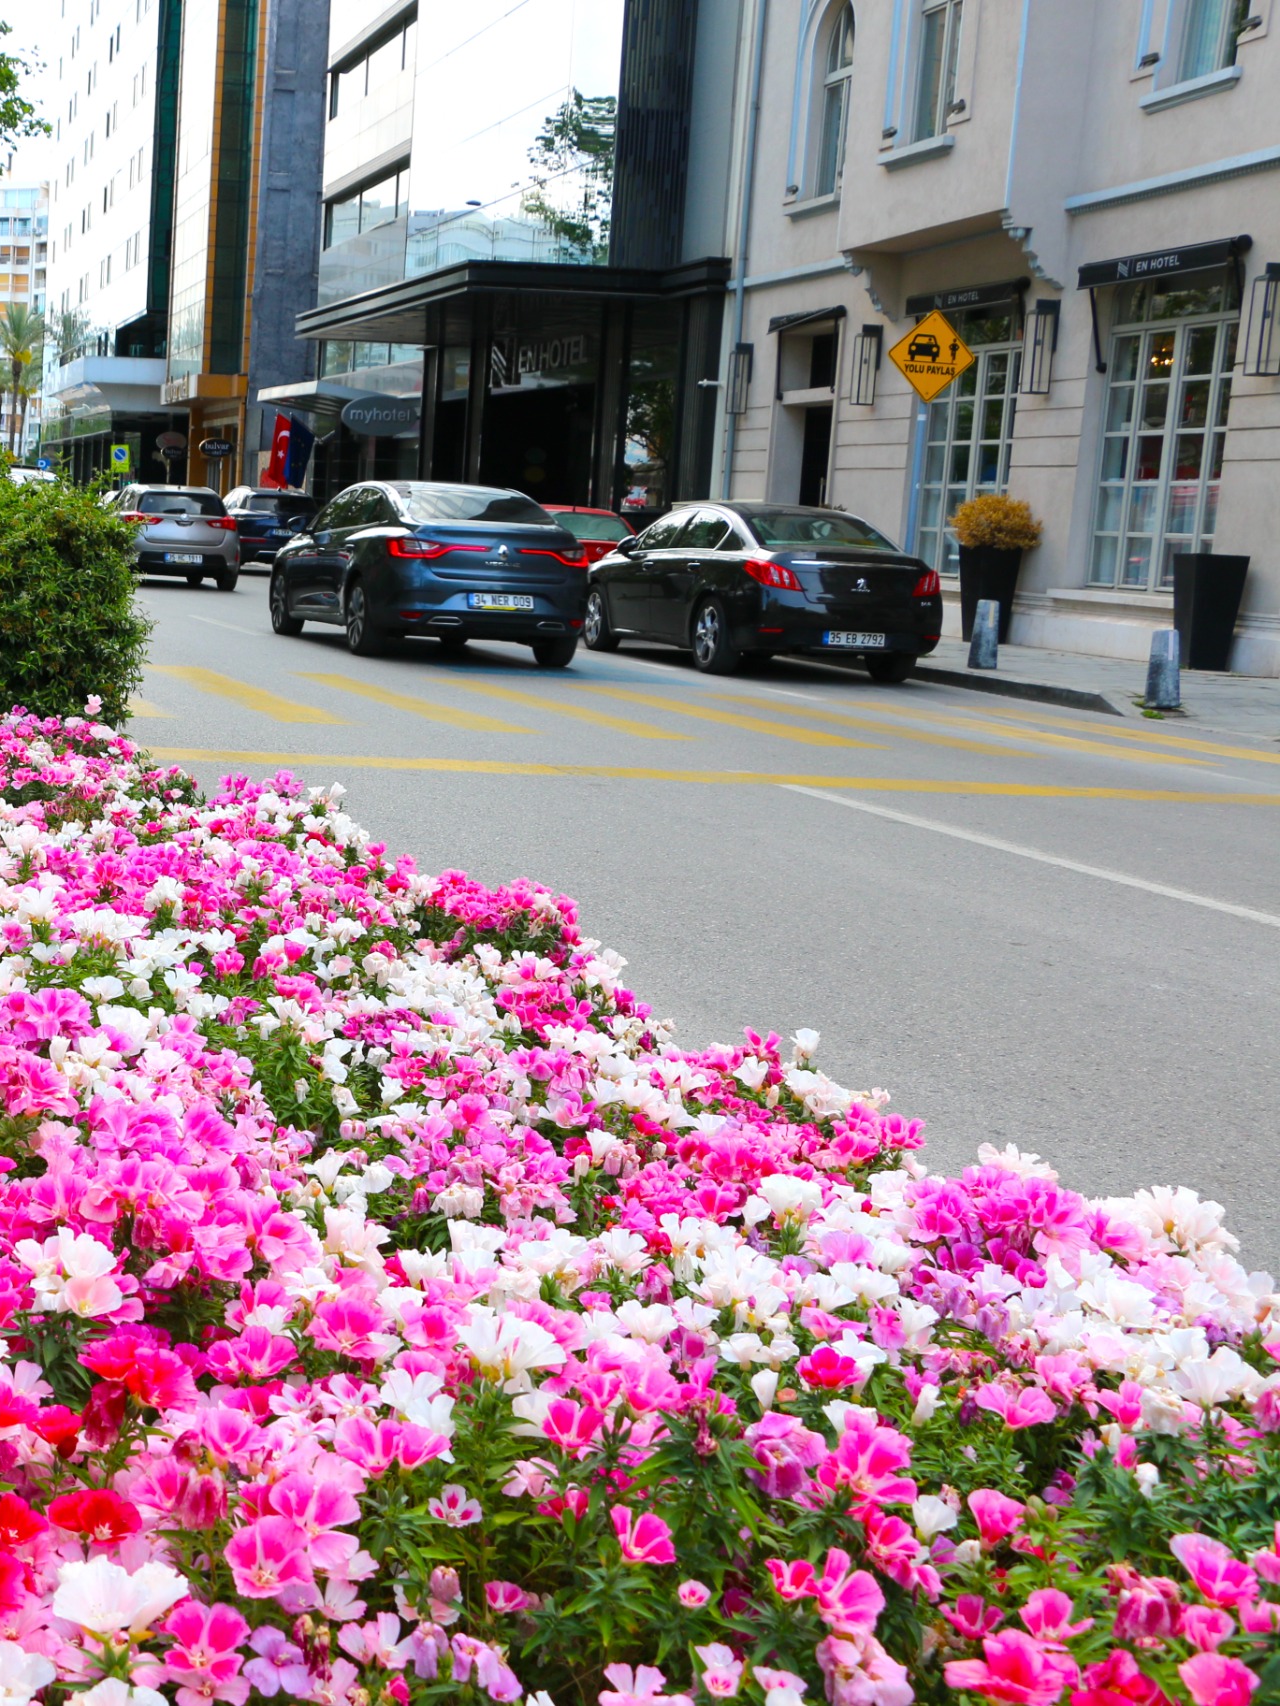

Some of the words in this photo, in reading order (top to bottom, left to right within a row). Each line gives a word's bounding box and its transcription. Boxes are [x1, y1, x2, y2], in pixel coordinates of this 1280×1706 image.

[1136, 260, 1148, 272] EN
[1150, 254, 1180, 269] HOTEL
[947, 295, 956, 304] EN
[958, 291, 979, 303] HOTEL
[518, 344, 538, 373] EN
[539, 334, 588, 371] HOTEL
[905, 363, 925, 374] YOLU
[350, 409, 411, 424] myhotel
[205, 441, 229, 450] bulvar
[474, 594, 486, 605] 34
[491, 595, 509, 606] NER
[513, 596, 531, 607] 009
[830, 632, 841, 643] 35
[846, 633, 858, 644] EB
[861, 634, 884, 646] 2792
